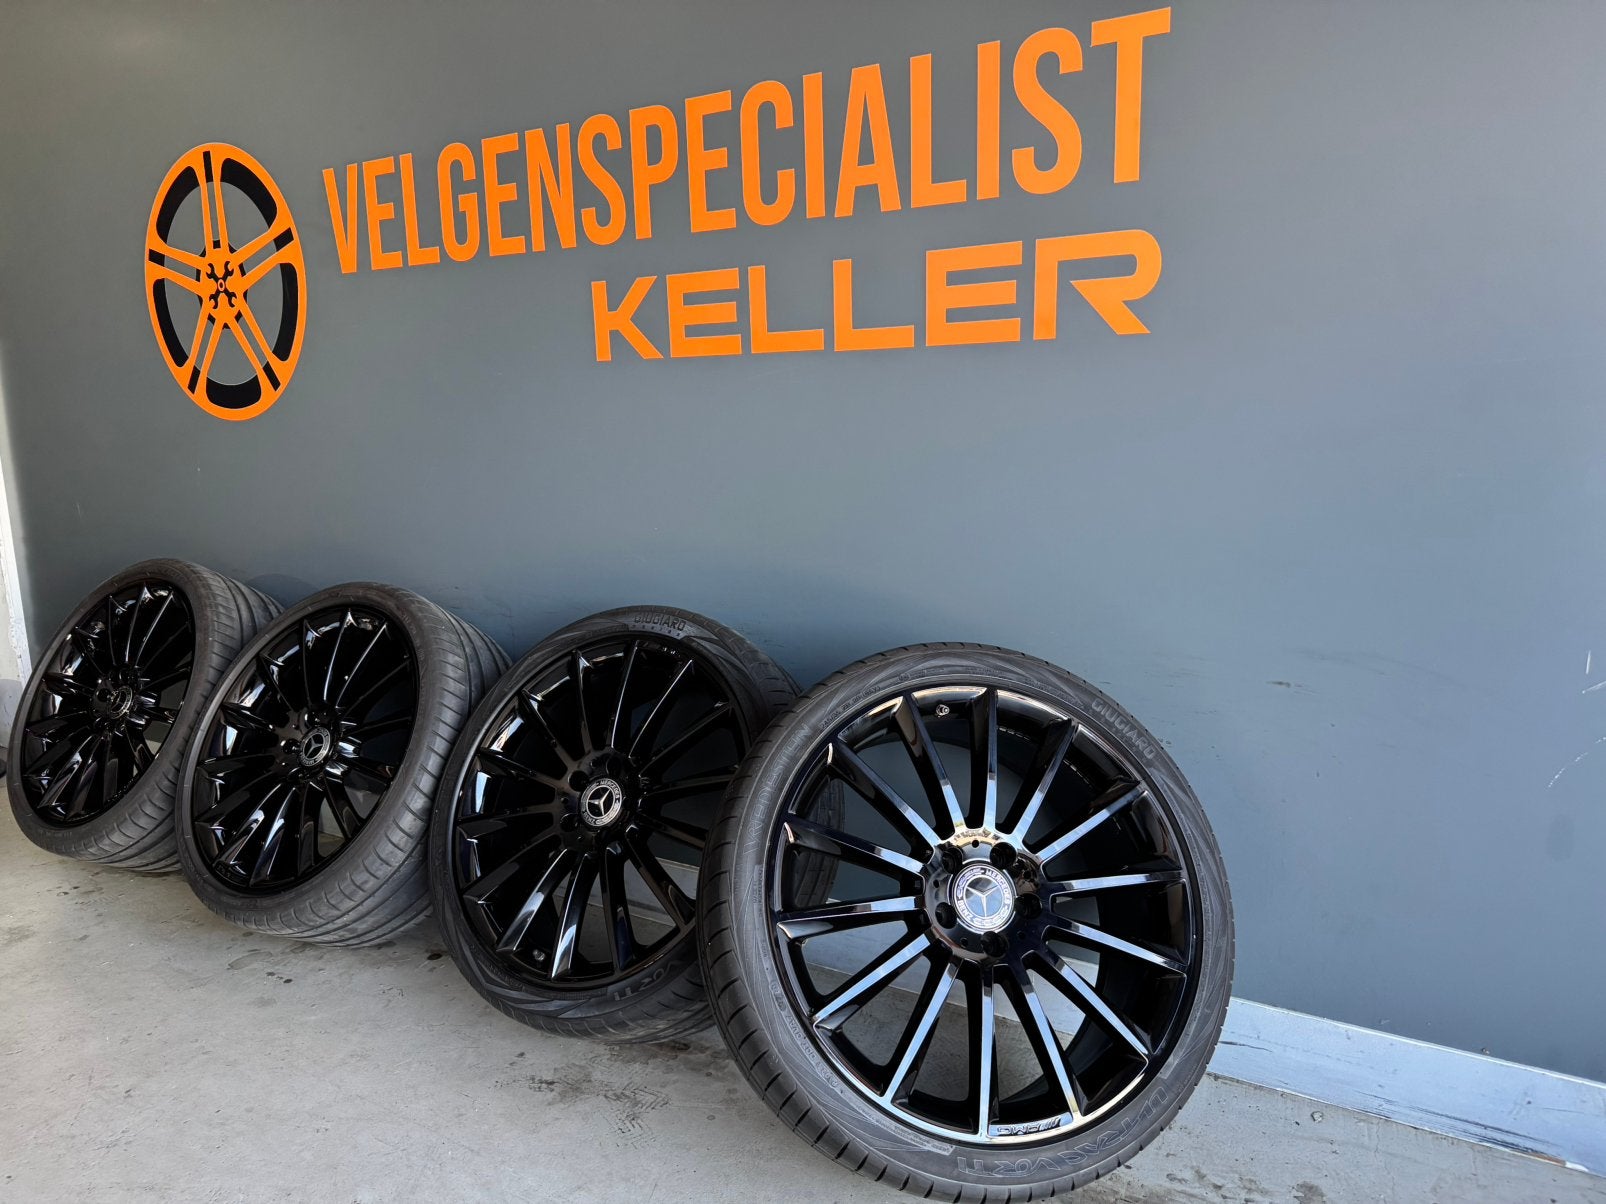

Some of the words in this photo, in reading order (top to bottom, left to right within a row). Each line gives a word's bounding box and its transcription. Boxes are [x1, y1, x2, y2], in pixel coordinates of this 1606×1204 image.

[322, 7, 1172, 275] VELGENSPECIALIST
[591, 229, 1163, 363] KELLER
[1091, 697, 1157, 760] GIUGIARO
[1060, 1086, 1169, 1165] ULTRAC
[957, 1156, 1062, 1178] VORTI
